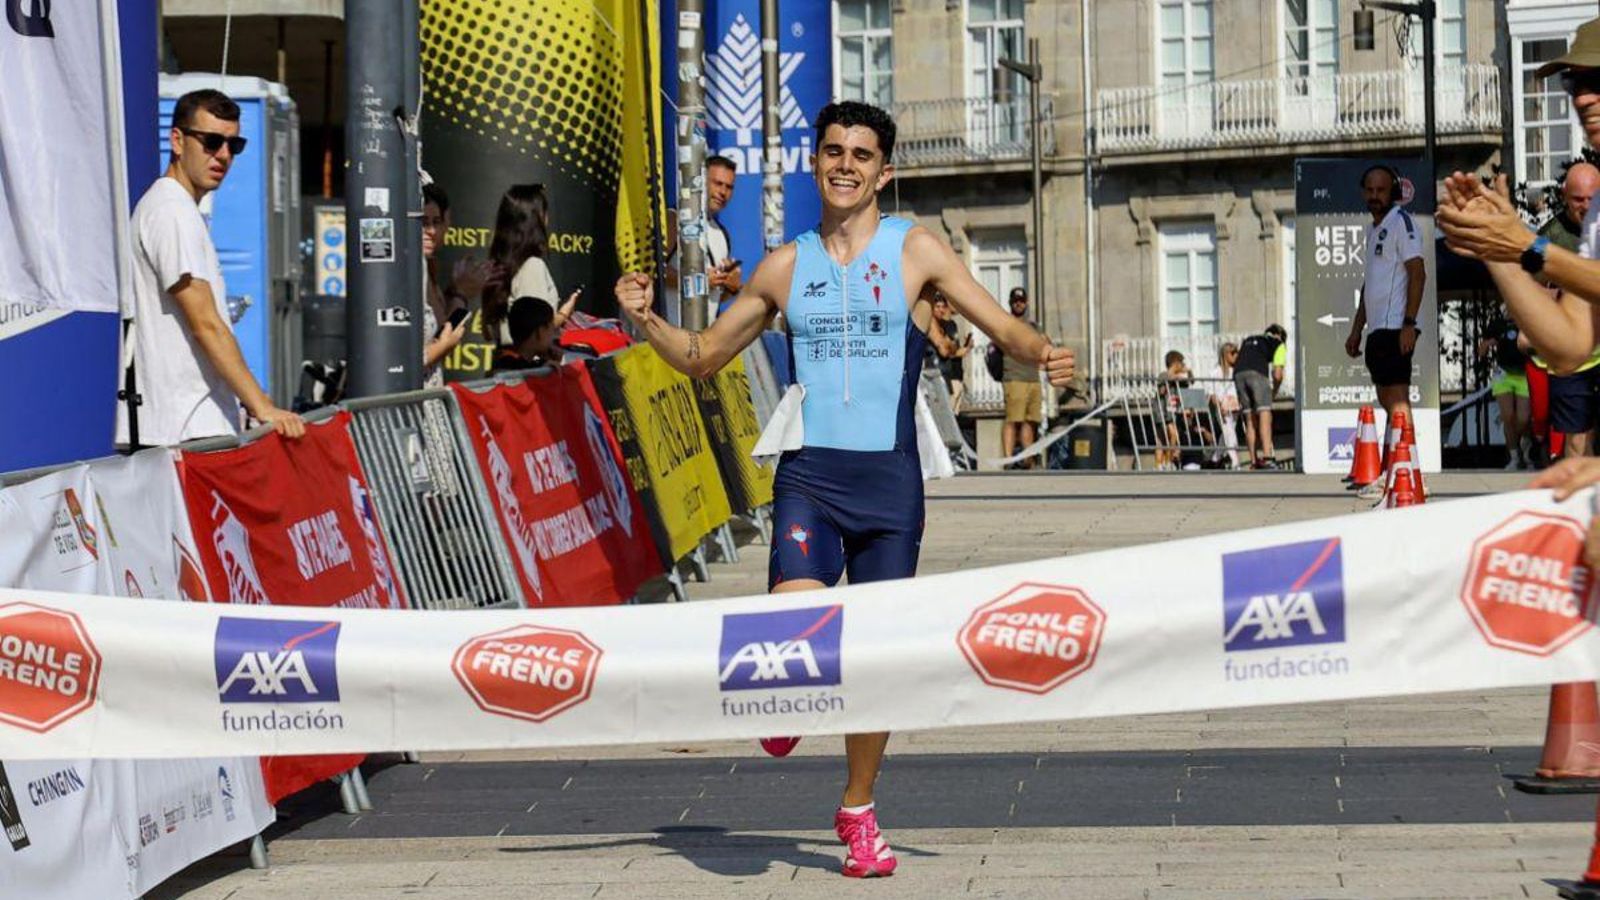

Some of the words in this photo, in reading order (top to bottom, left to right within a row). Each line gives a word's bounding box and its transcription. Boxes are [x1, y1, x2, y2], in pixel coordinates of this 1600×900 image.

[444, 226, 490, 247] RIST
[549, 233, 593, 253] ACK?
[1315, 225, 1366, 246] MET
[445, 344, 496, 371] IST
[829, 349, 842, 358] DE
[1319, 393, 1421, 403] PONLEFO
[1487, 547, 1588, 591] PONLE
[1479, 575, 1580, 618] FRENO
[986, 612, 1090, 636] PONLE
[1225, 591, 1326, 644] AXA
[0, 635, 82, 675] ONLE
[482, 640, 584, 667] PONLE
[976, 625, 1081, 662] FRENO
[0, 656, 78, 696] RENO
[219, 650, 319, 695] AXA
[472, 650, 575, 691] FRENO
[720, 638, 822, 683] AXA
[1225, 651, 1349, 681] fundación
[221, 708, 344, 732] fundación
[721, 692, 845, 717] fundación
[27, 765, 85, 807] CHANGAN
